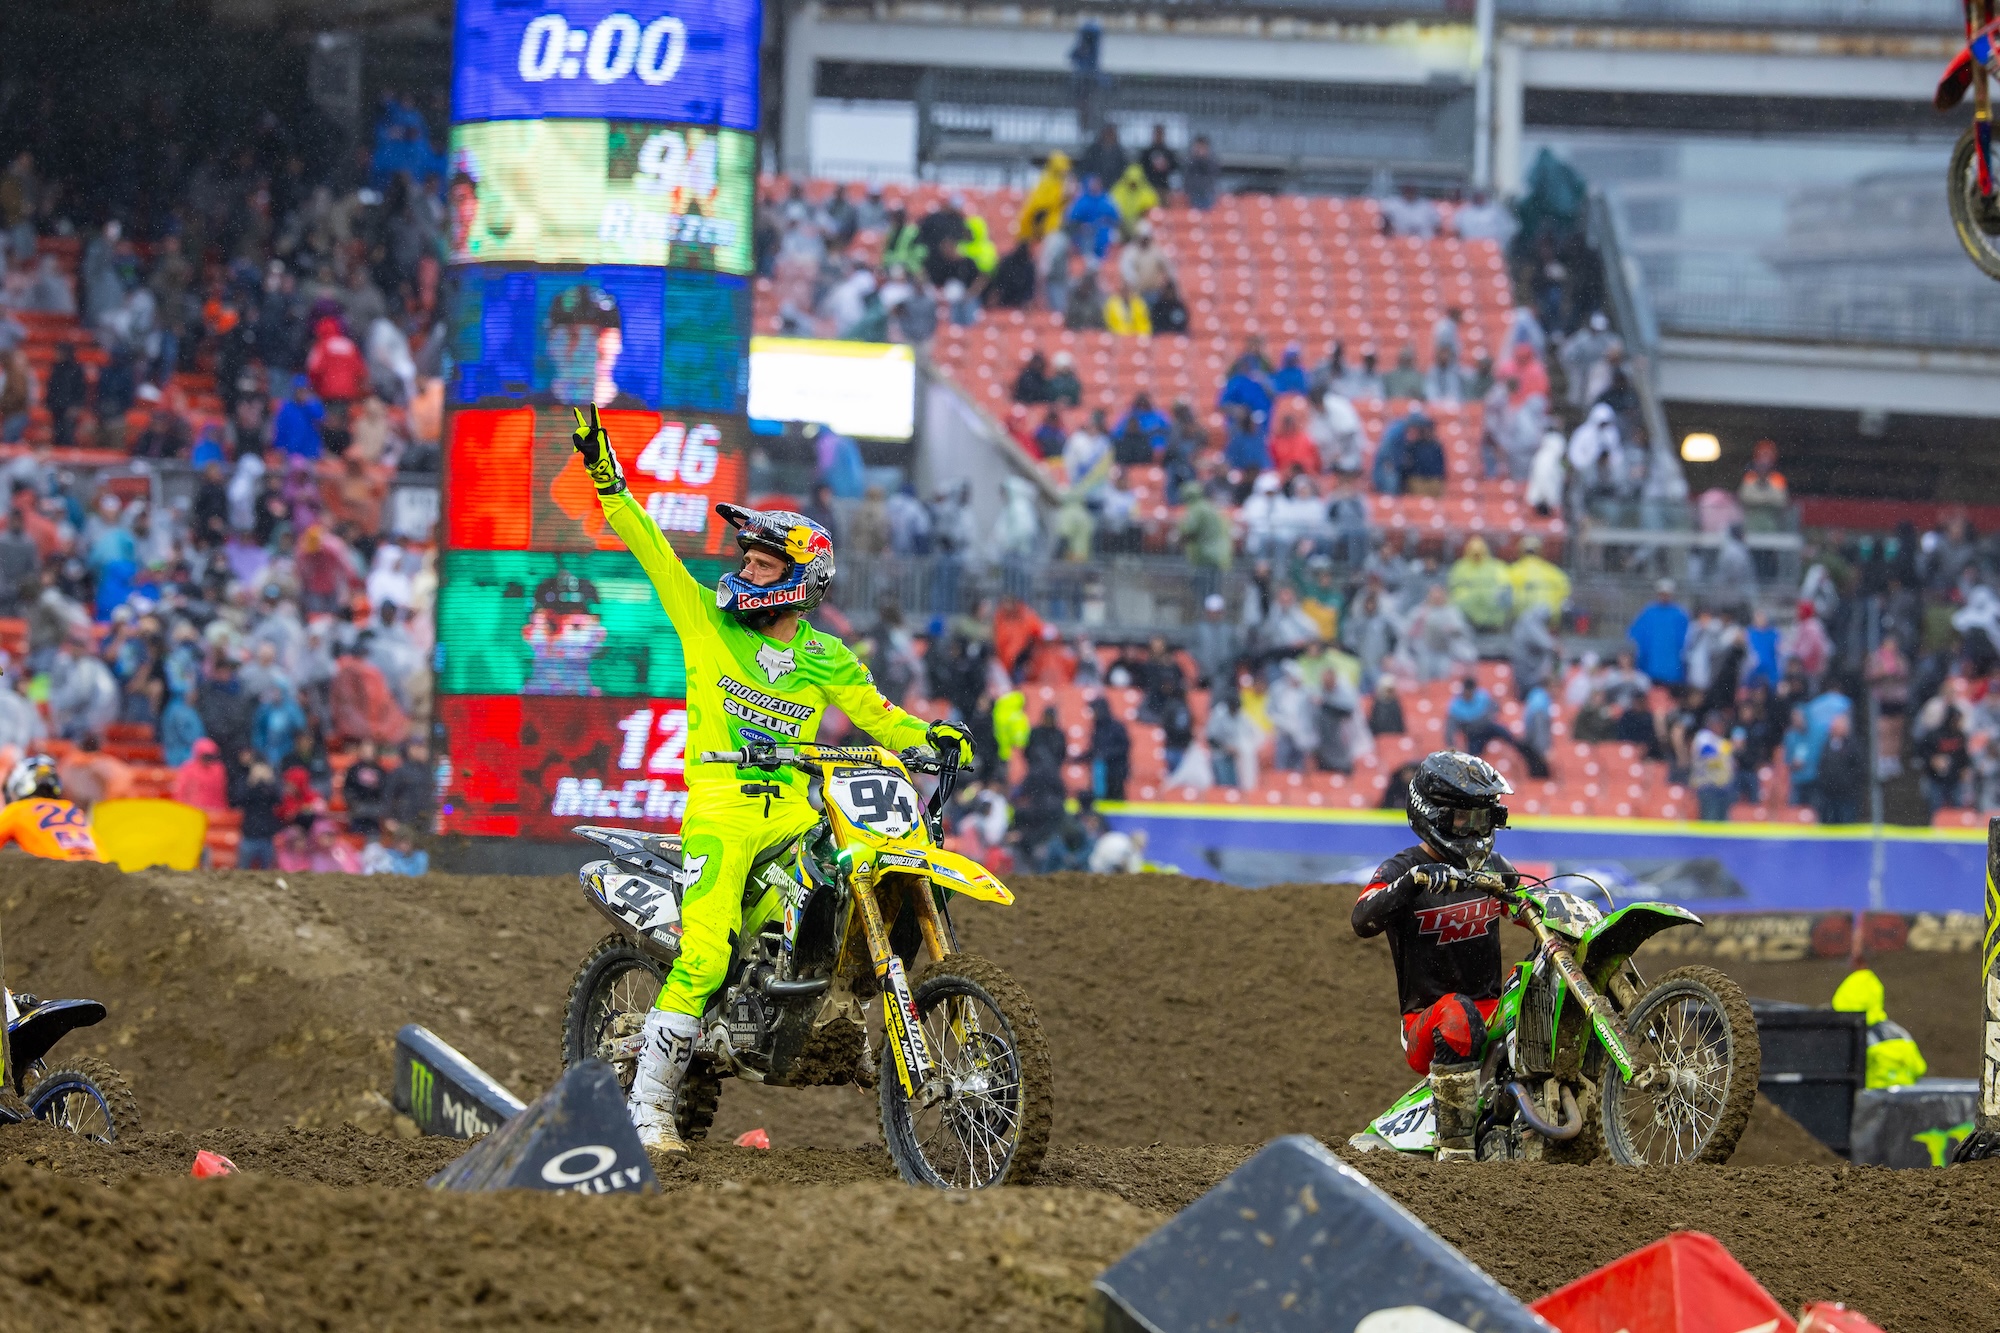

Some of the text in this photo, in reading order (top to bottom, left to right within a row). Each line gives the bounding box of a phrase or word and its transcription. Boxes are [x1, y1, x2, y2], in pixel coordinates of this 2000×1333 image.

[518, 13, 687, 86] 0:00
[638, 129, 718, 201] 94
[636, 422, 722, 486] 46
[737, 583, 806, 611] Red Bull
[717, 675, 816, 721] PROGRESSIVE
[723, 698, 801, 738] SUZUKI
[617, 709, 687, 774] 12
[850, 779, 914, 823] 94
[608, 836, 636, 851] DUNLOP
[879, 853, 923, 868] PROGRESSIVE
[608, 878, 668, 927] 94
[761, 861, 811, 909] PROGRESSIVE
[1414, 897, 1502, 934] TRUE
[1436, 919, 1489, 945] MX
[730, 1023, 758, 1032] SUZUKI
[899, 988, 930, 1067] DUNLOP
[1597, 1022, 1633, 1072] DUNLOP
[1380, 1104, 1431, 1137] 437
